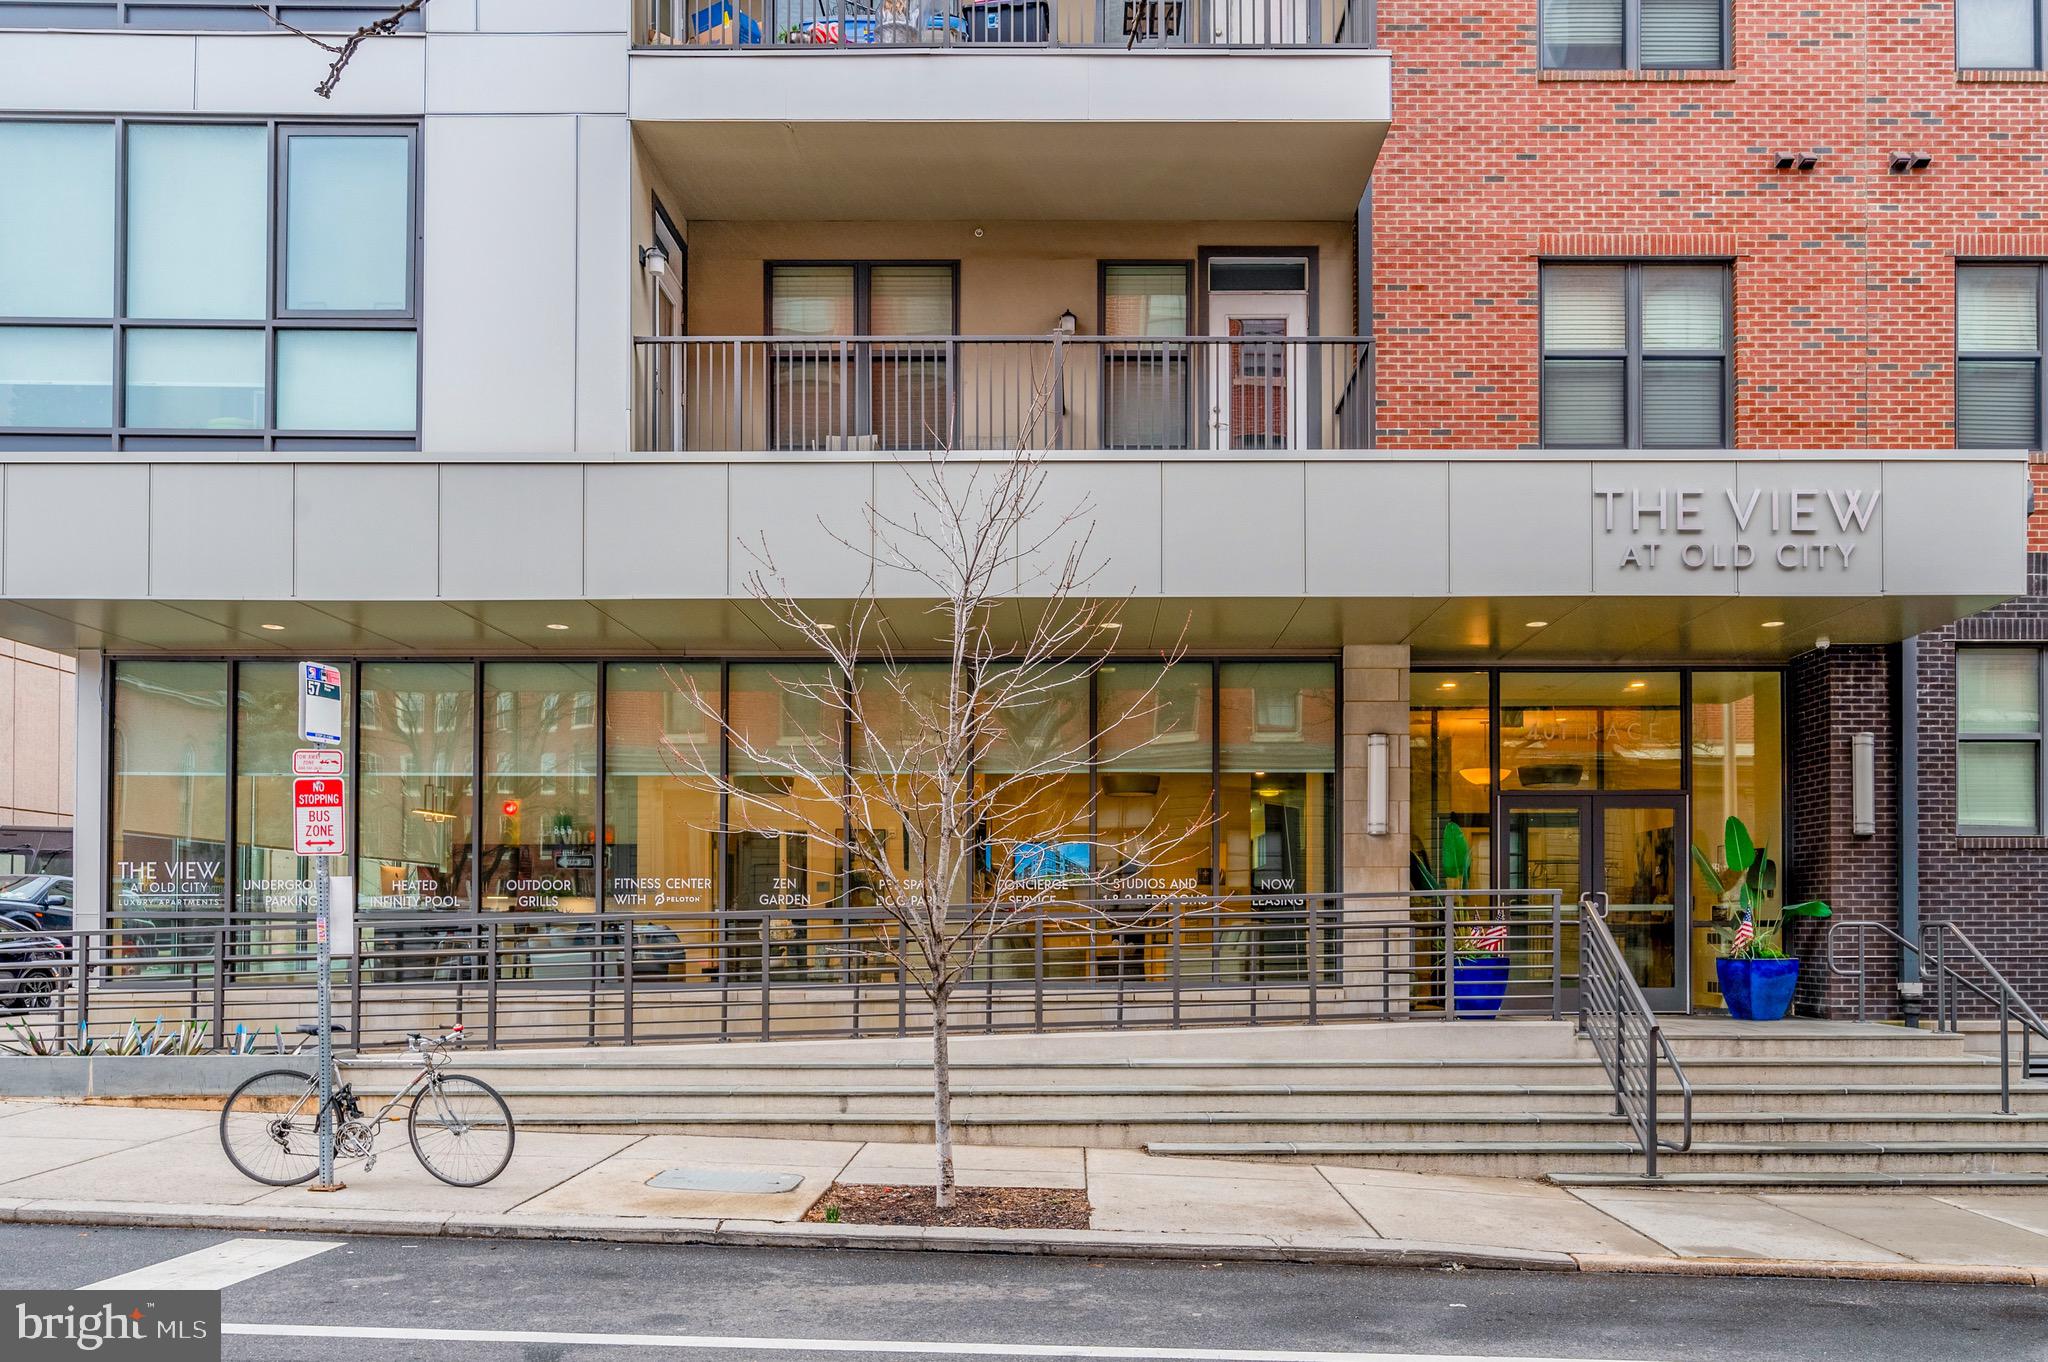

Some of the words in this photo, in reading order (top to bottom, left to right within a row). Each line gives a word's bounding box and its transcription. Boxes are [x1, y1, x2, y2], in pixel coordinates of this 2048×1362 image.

[1594, 487, 1704, 531] THE
[1725, 487, 1880, 532] VIEW
[1620, 543, 1661, 568] AT
[1681, 543, 1755, 570] OLD
[1775, 543, 1856, 570] CITY
[308, 680, 320, 695] 57
[313, 782, 325, 792] NO
[299, 794, 340, 805] STOPPING
[309, 810, 330, 822] BUS
[305, 825, 334, 837] ZONE
[118, 862, 157, 879] THE
[164, 862, 220, 879] VIEW
[130, 882, 144, 893] AT
[149, 882, 175, 893] OLD
[181, 882, 208, 893] CITY
[243, 879, 317, 890] UNDERGRO
[392, 880, 438, 891] HEATED
[506, 879, 571, 891] OUTDOOR
[614, 878, 661, 889] FITNESS
[665, 878, 712, 889] CENTER
[773, 878, 797, 889] ZEN
[1113, 878, 1166, 889] STUDIOS
[1170, 878, 1197, 889] AND
[1261, 879, 1295, 890] NOW
[265, 895, 318, 906] PARKING
[370, 895, 420, 907] INFINITY
[425, 895, 460, 907] POOL
[518, 895, 559, 907] GRILLS
[614, 894, 646, 905] WITH
[759, 894, 811, 905] GARDEN
[1252, 898, 1304, 906] LEASING
